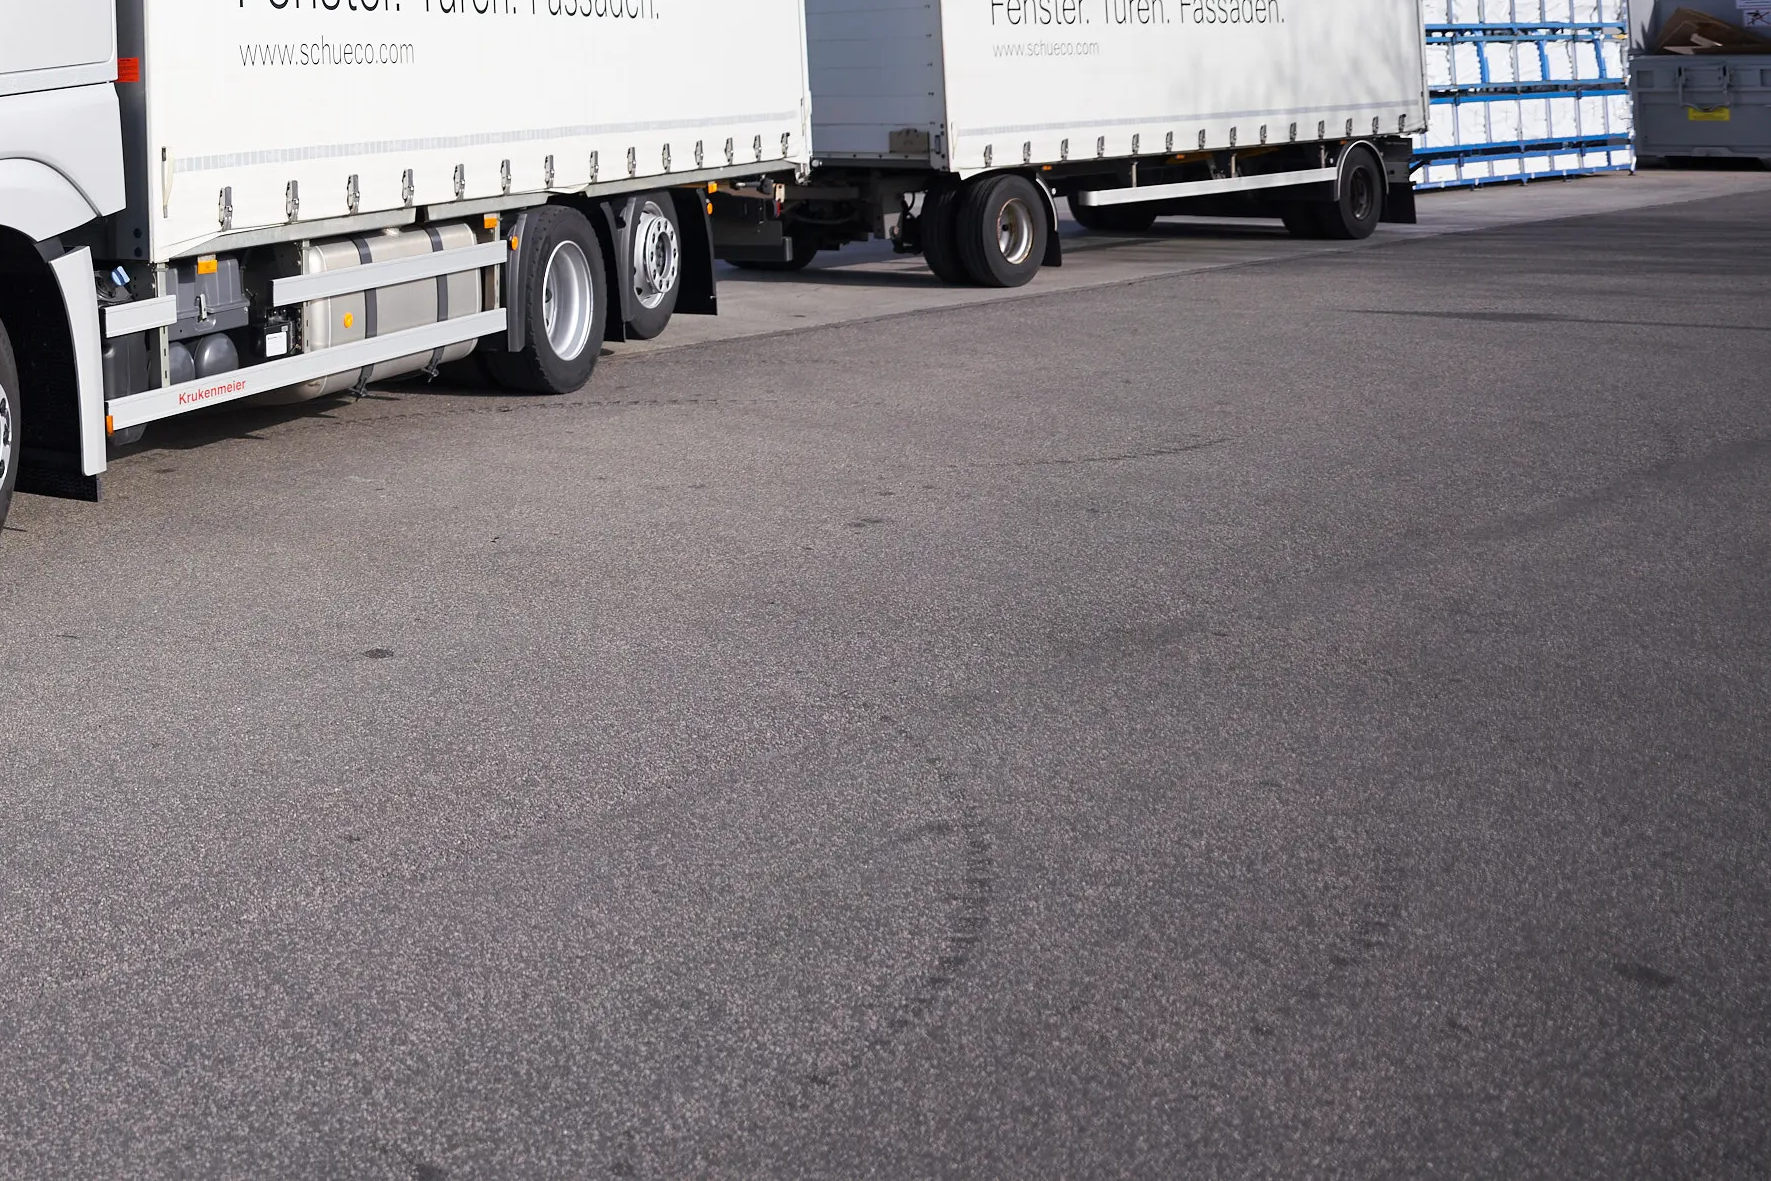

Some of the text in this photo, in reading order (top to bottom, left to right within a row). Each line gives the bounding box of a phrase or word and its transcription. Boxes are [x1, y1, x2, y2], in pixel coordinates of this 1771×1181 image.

[238, 35, 415, 67] www.schueco.com
[992, 39, 1100, 58] www.schueco.com
[178, 380, 246, 405] Krukenmeier
